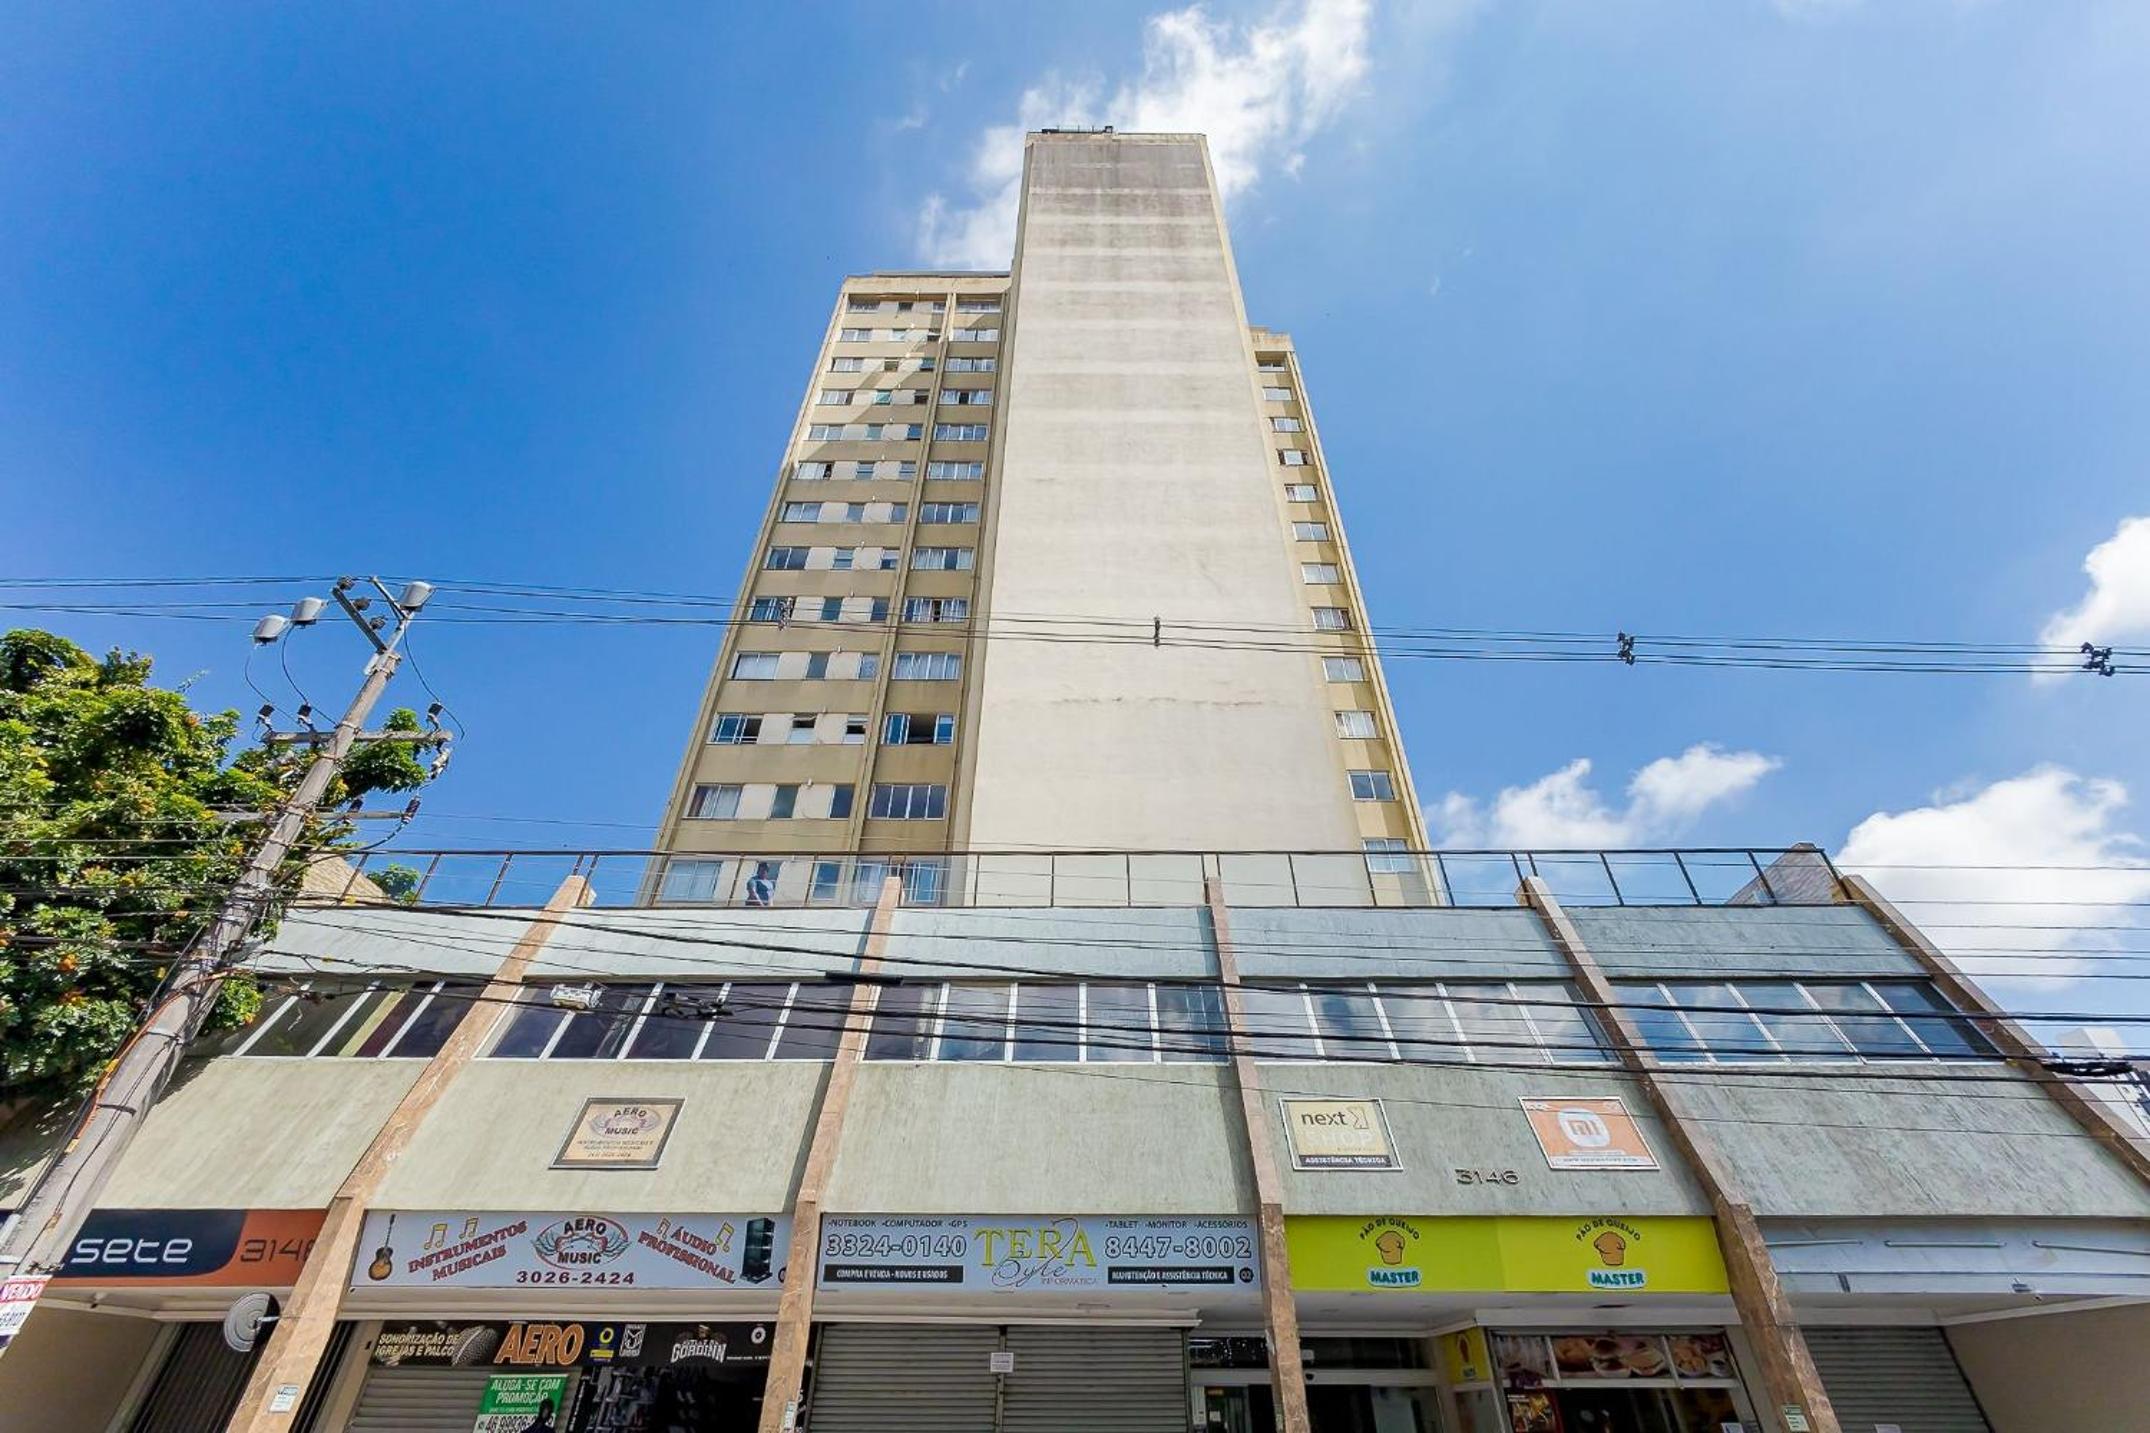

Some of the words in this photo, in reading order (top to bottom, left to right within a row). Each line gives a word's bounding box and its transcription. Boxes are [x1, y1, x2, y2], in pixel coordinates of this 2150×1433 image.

[614, 1106, 648, 1117] AERO
[1301, 1111, 1348, 1126] next
[605, 1127, 640, 1135] MUSIC
[1455, 1168, 1519, 1185] 3146
[563, 1218, 607, 1235] AERO
[1389, 1217, 1419, 1240] QUEIJO
[1576, 1223, 1591, 1240] PÃO
[1606, 1218, 1640, 1240] QUEIJO
[408, 1220, 528, 1273] INSTRUMENTOS
[671, 1226, 718, 1256] ÁUDIO
[826, 1234, 967, 1257] 3324-0140
[973, 1226, 1098, 1268] TERA
[1105, 1236, 1252, 1258] 8447-8002
[432, 1245, 507, 1281] MUSICAIS
[557, 1252, 602, 1264] MUSIC
[516, 1270, 634, 1284] 3026-2424
[1370, 1270, 1420, 1284] MASTER
[1591, 1271, 1645, 1285] MASTER
[380, 1331, 445, 1346] SONORIZAÇÃO
[493, 1323, 585, 1365] AERO
[375, 1345, 416, 1356] IGREJAS
[424, 1346, 455, 1356] PALCO
[490, 1379, 536, 1391] ALUGA-SE
[539, 1378, 561, 1391] COM
